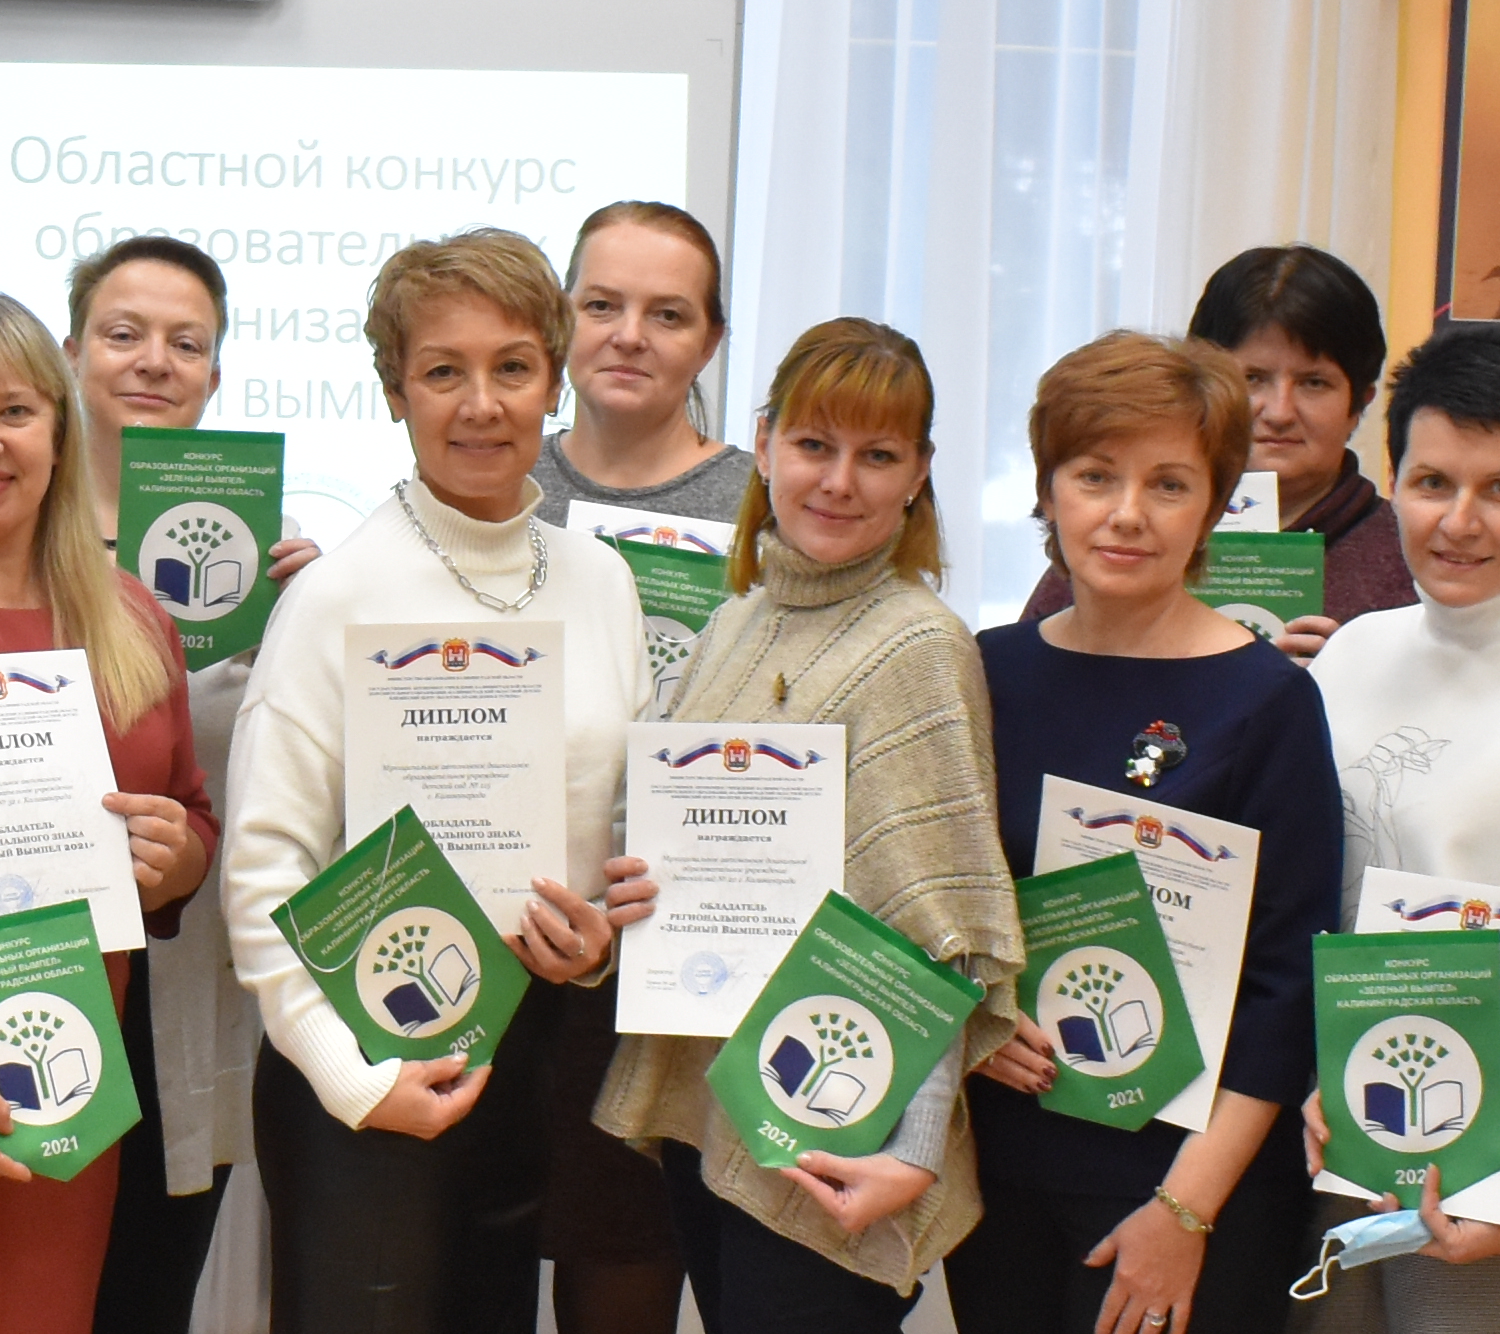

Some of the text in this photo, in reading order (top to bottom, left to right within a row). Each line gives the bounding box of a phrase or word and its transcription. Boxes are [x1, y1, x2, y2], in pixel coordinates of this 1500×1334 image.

[8, 133, 579, 204] Областной конкурс
[184, 452, 223, 461] КОНКУРС
[179, 635, 214, 649] 2021
[401, 708, 507, 727] ДИПЛОМ
[682, 808, 788, 826] ДИПЛОМ
[338, 867, 375, 897] КОНКУРС
[1384, 958, 1429, 968] КОНКУРС
[450, 1024, 486, 1056] 2021
[1106, 1088, 1146, 1109] 2021
[41, 1136, 79, 1157] 2021
[1395, 1169, 1427, 1185] 202
